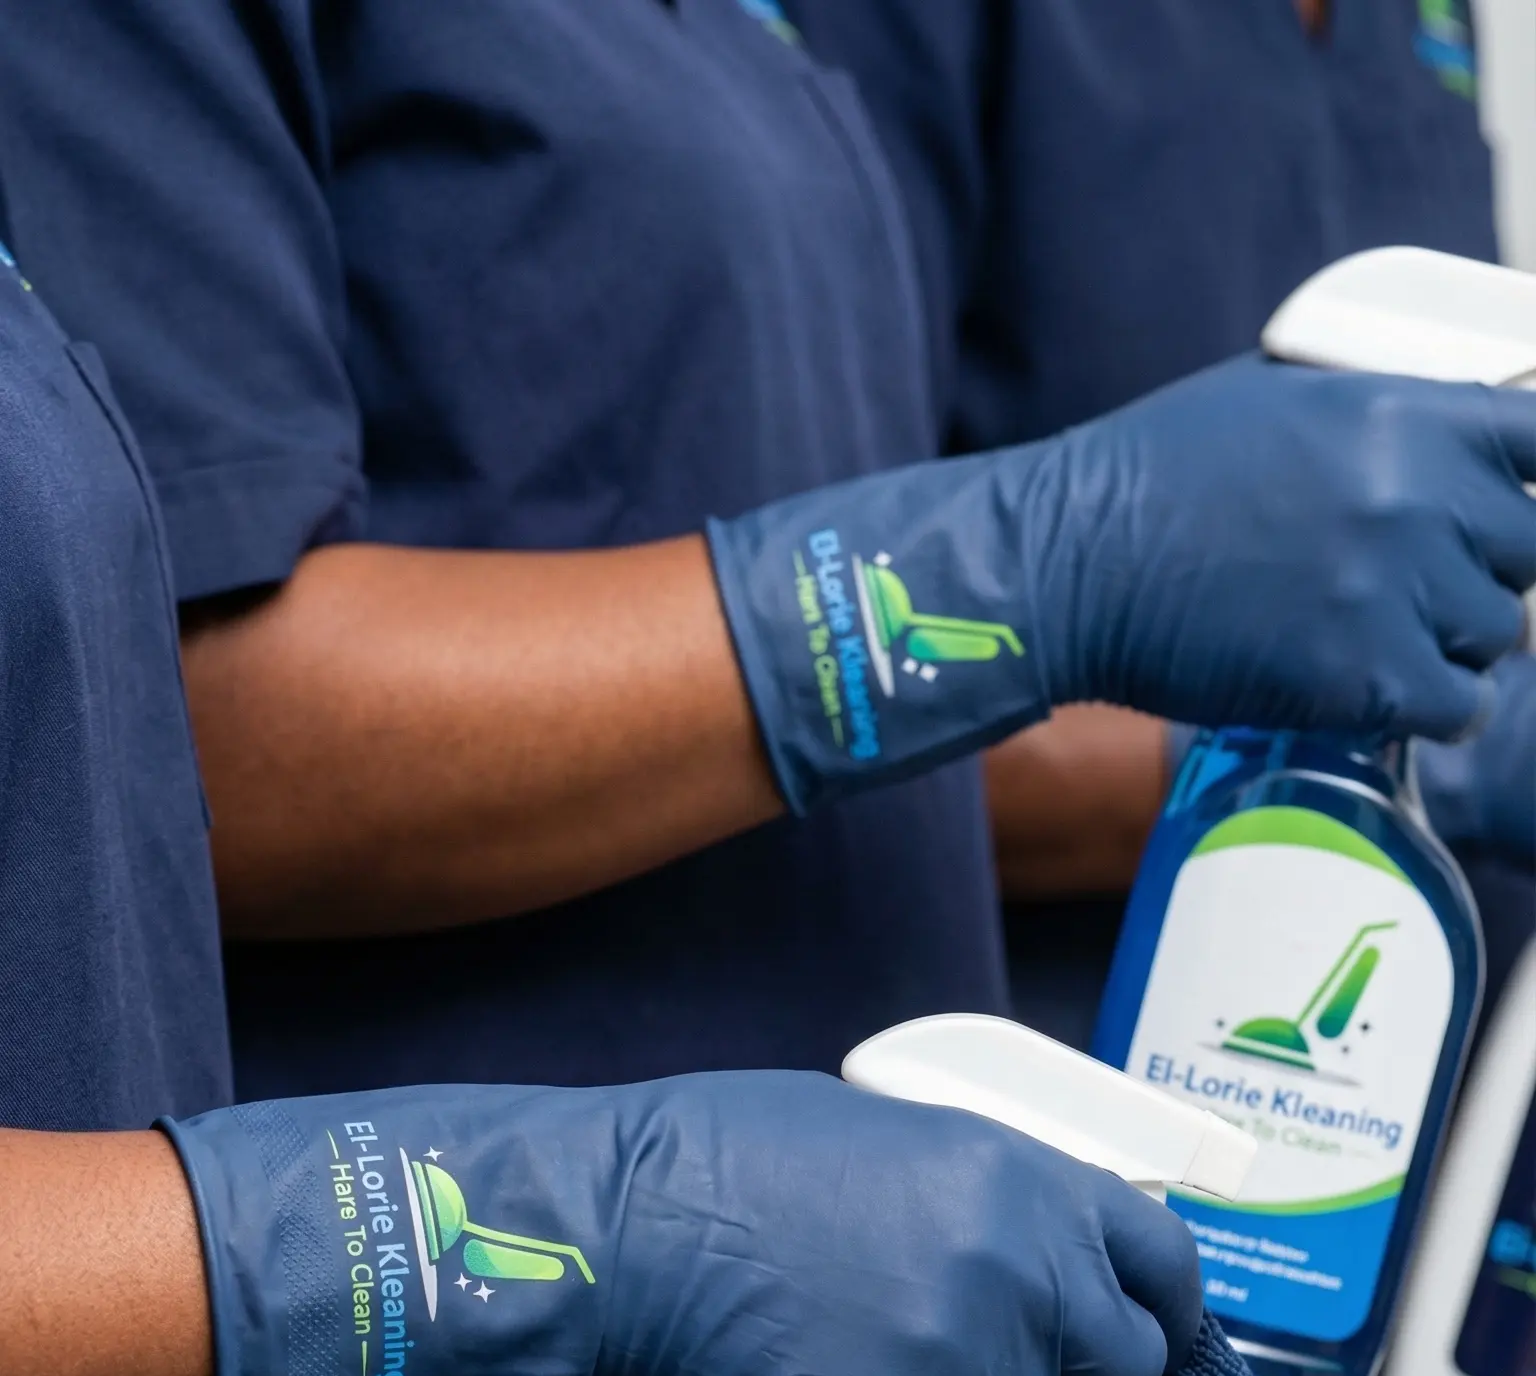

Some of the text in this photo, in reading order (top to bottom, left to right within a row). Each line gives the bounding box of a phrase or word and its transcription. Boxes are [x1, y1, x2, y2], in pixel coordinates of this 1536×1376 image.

[1145, 1053, 1405, 1151] El-Lorie Kleaning
[344, 1121, 399, 1234] El-Lorie
[344, 1225, 366, 1255] To
[350, 1263, 375, 1336] Clean
